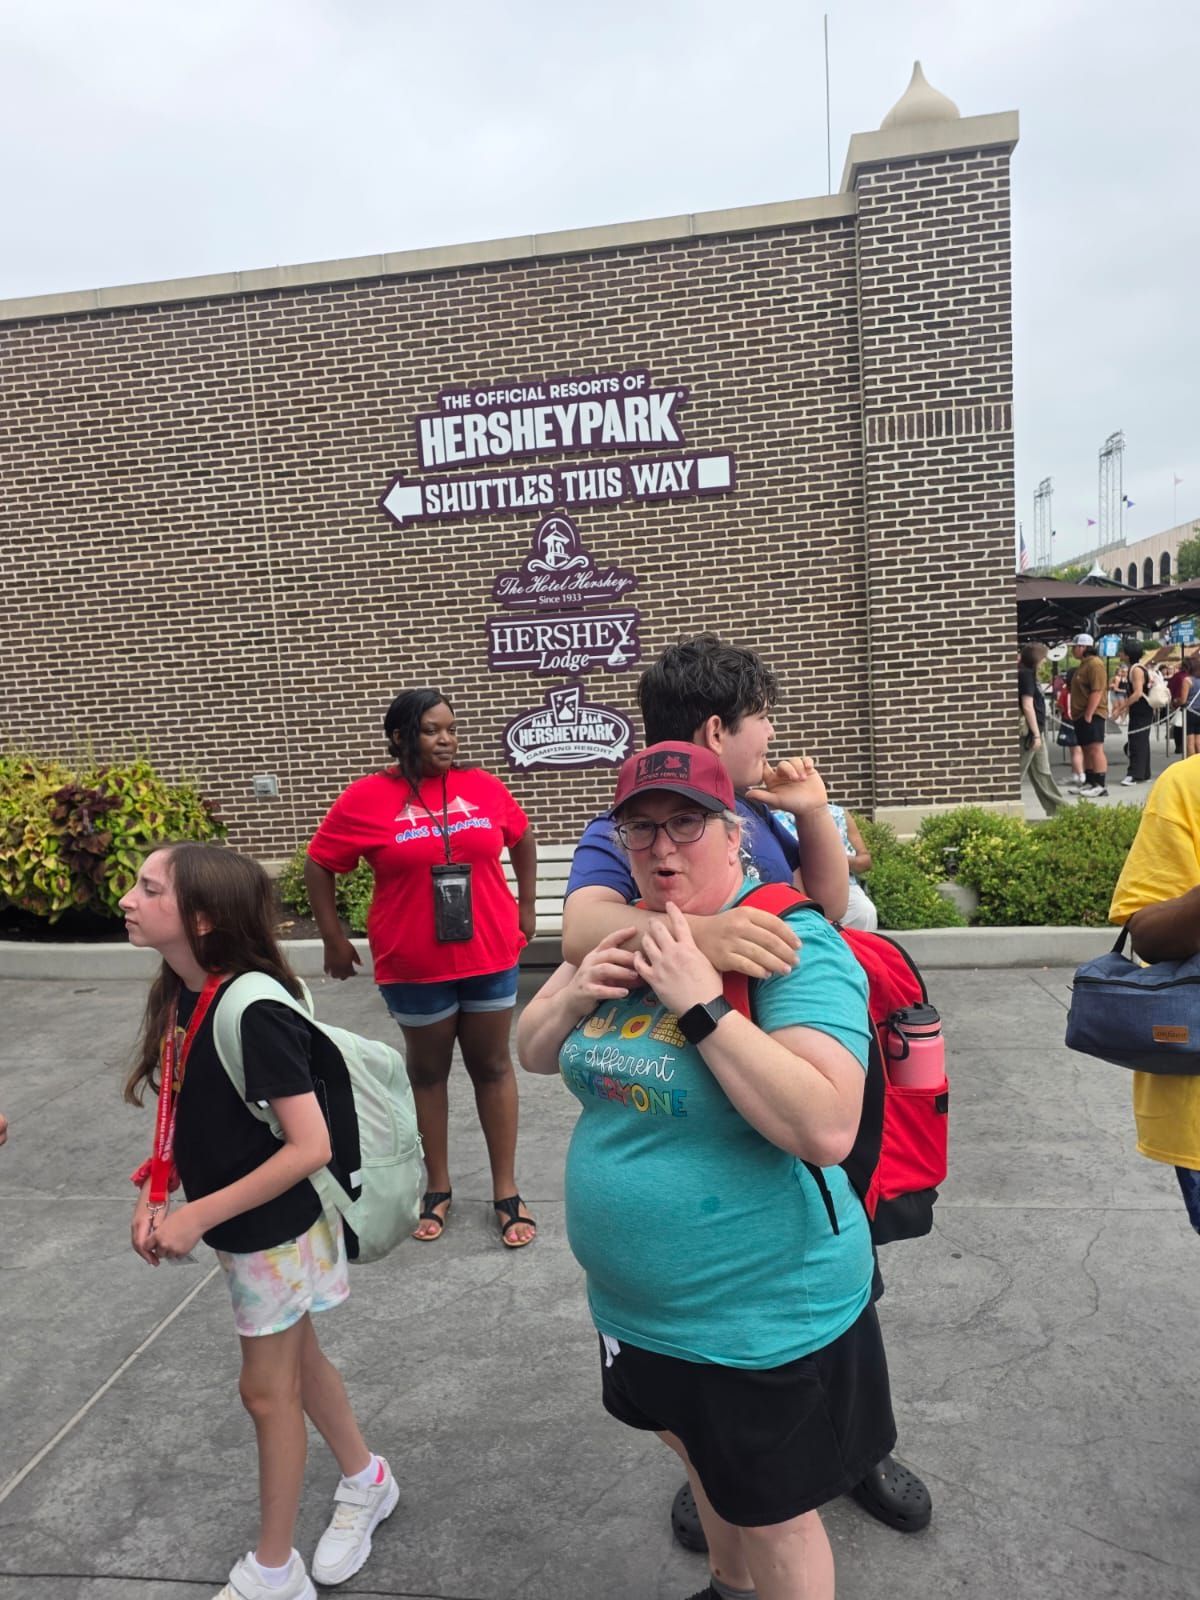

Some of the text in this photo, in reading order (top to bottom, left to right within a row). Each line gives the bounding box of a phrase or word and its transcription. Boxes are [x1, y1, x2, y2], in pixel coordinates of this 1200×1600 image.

[442, 374, 646, 410] THE OFFICIAL RESORTS OF
[420, 392, 680, 467] HERSHEYPARK
[425, 459, 694, 514] SHUTTLES THIS WAY
[497, 570, 628, 596] The Hotel Hershey
[538, 593, 582, 605] Since 1933
[491, 619, 635, 654] HERSHEY
[539, 650, 591, 672] Lodge
[518, 723, 616, 747] HERSHEYPARK
[526, 745, 613, 761] CAMPING RESORT
[584, 1044, 676, 1082] different
[570, 1067, 688, 1118] EVERYONE
